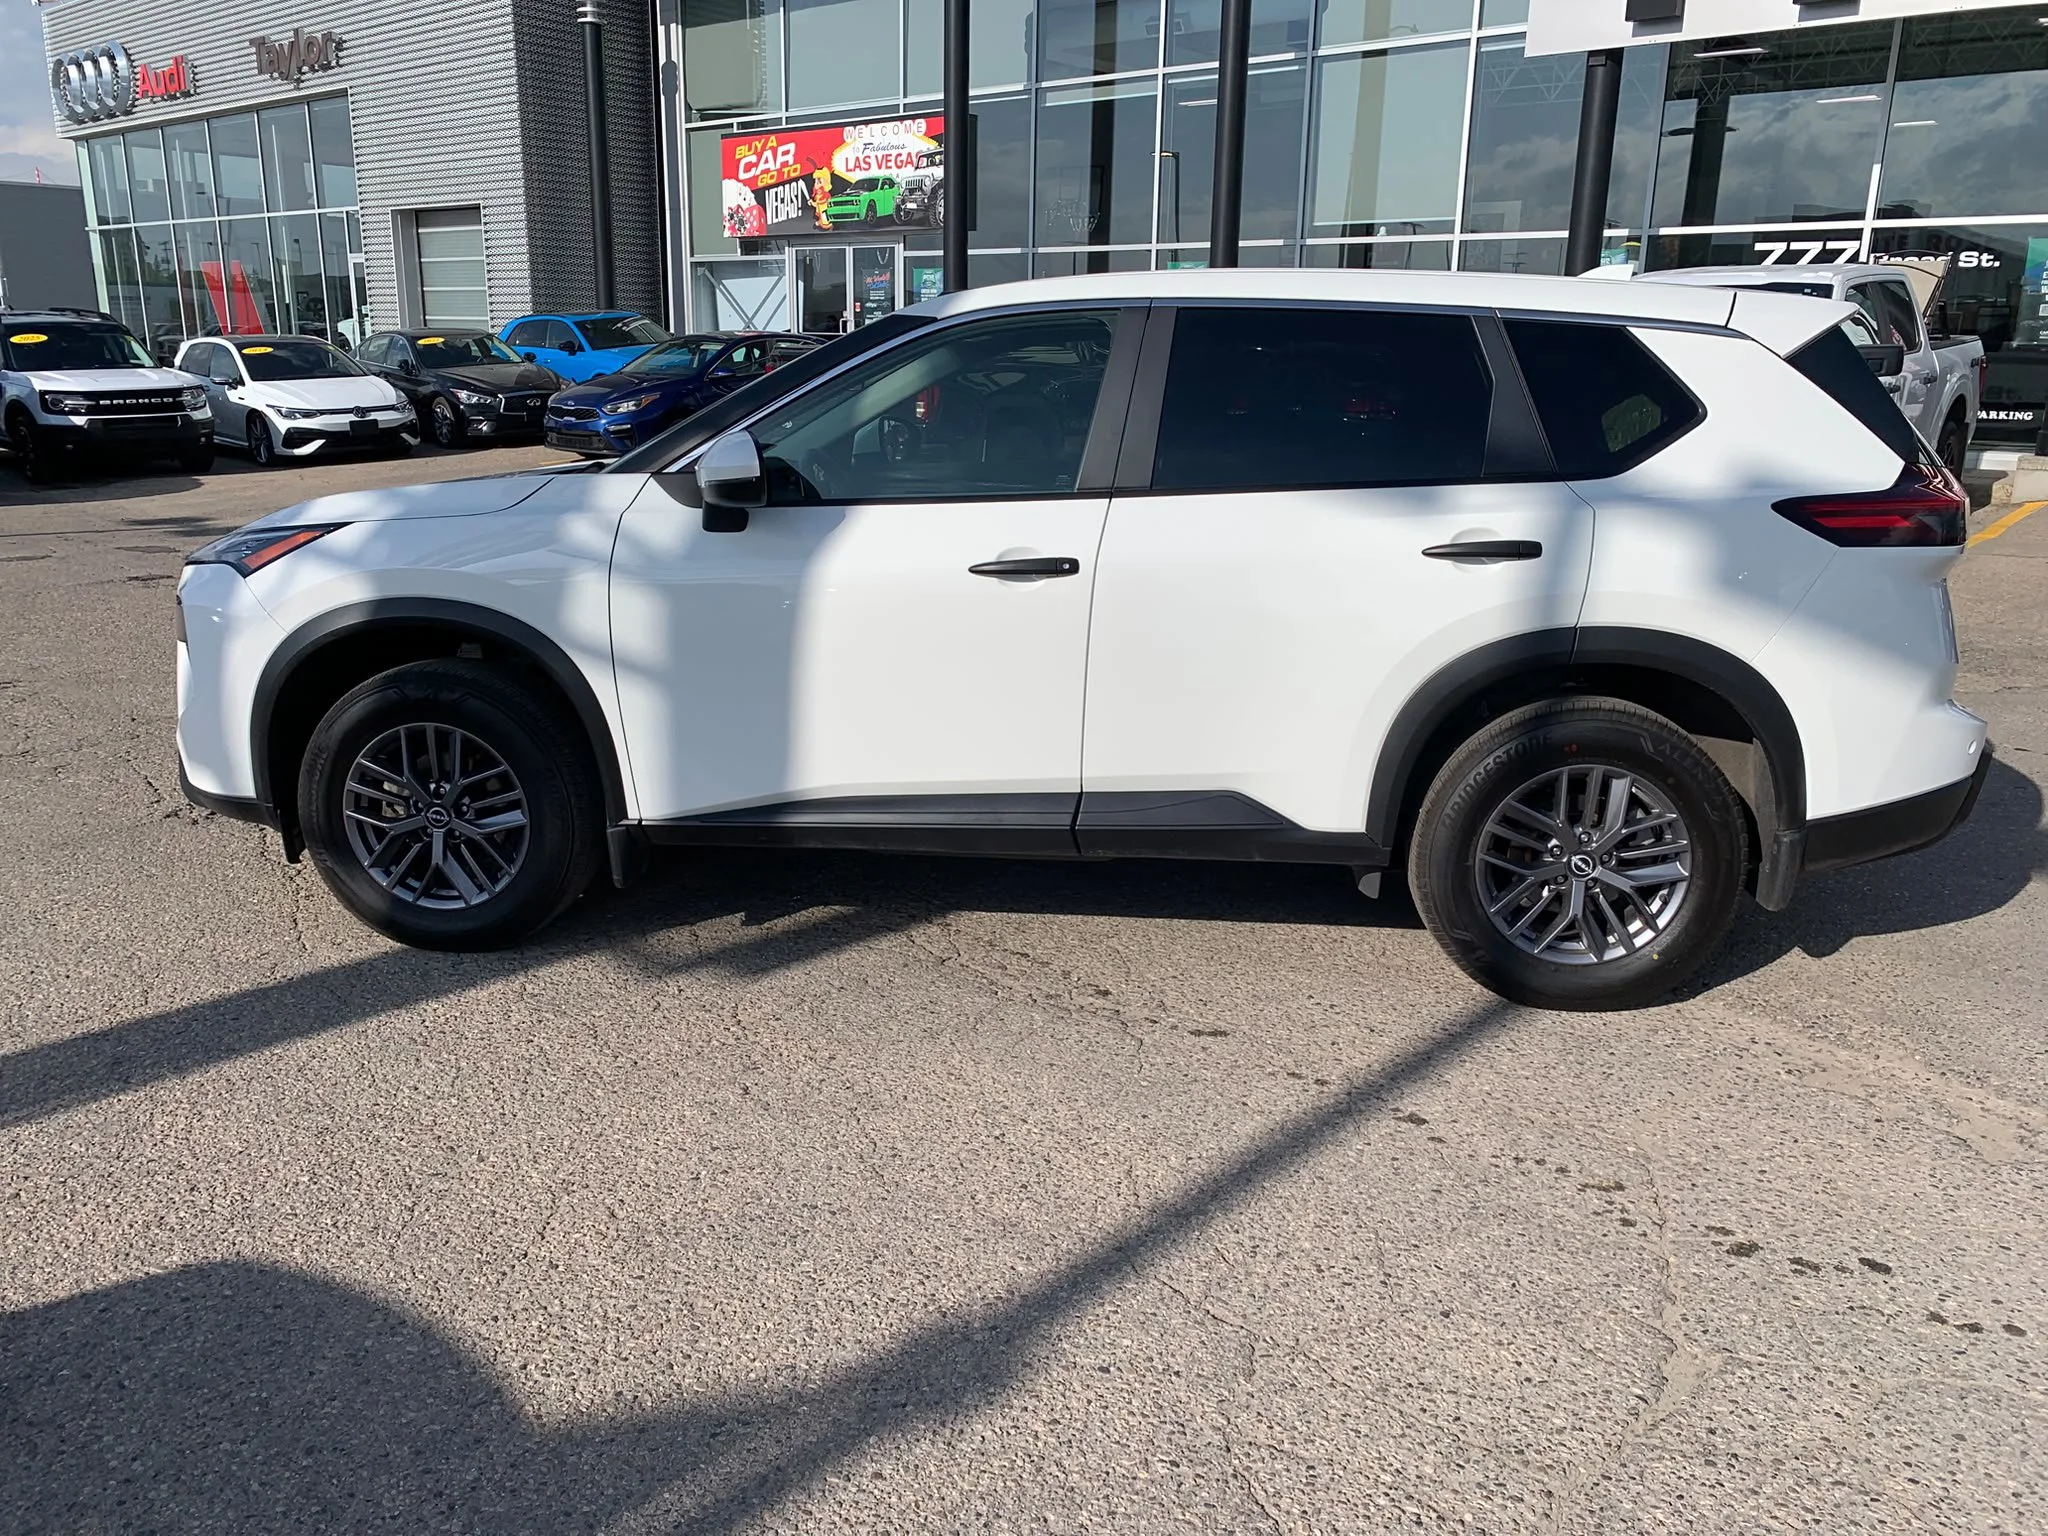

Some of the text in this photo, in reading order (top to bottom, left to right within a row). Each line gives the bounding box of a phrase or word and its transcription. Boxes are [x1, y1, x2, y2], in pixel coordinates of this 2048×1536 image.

[249, 28, 333, 81] Taylor
[138, 55, 186, 98] Audi
[845, 121, 923, 140] WELCOME
[735, 136, 777, 159] BUY A
[862, 142, 907, 155] Fabulous
[738, 142, 796, 180] CAR
[845, 155, 871, 172] LAS
[757, 164, 801, 187] GO TO
[765, 180, 802, 225] VEGAS!
[1754, 240, 1860, 266] 777
[1958, 251, 2001, 268] St.
